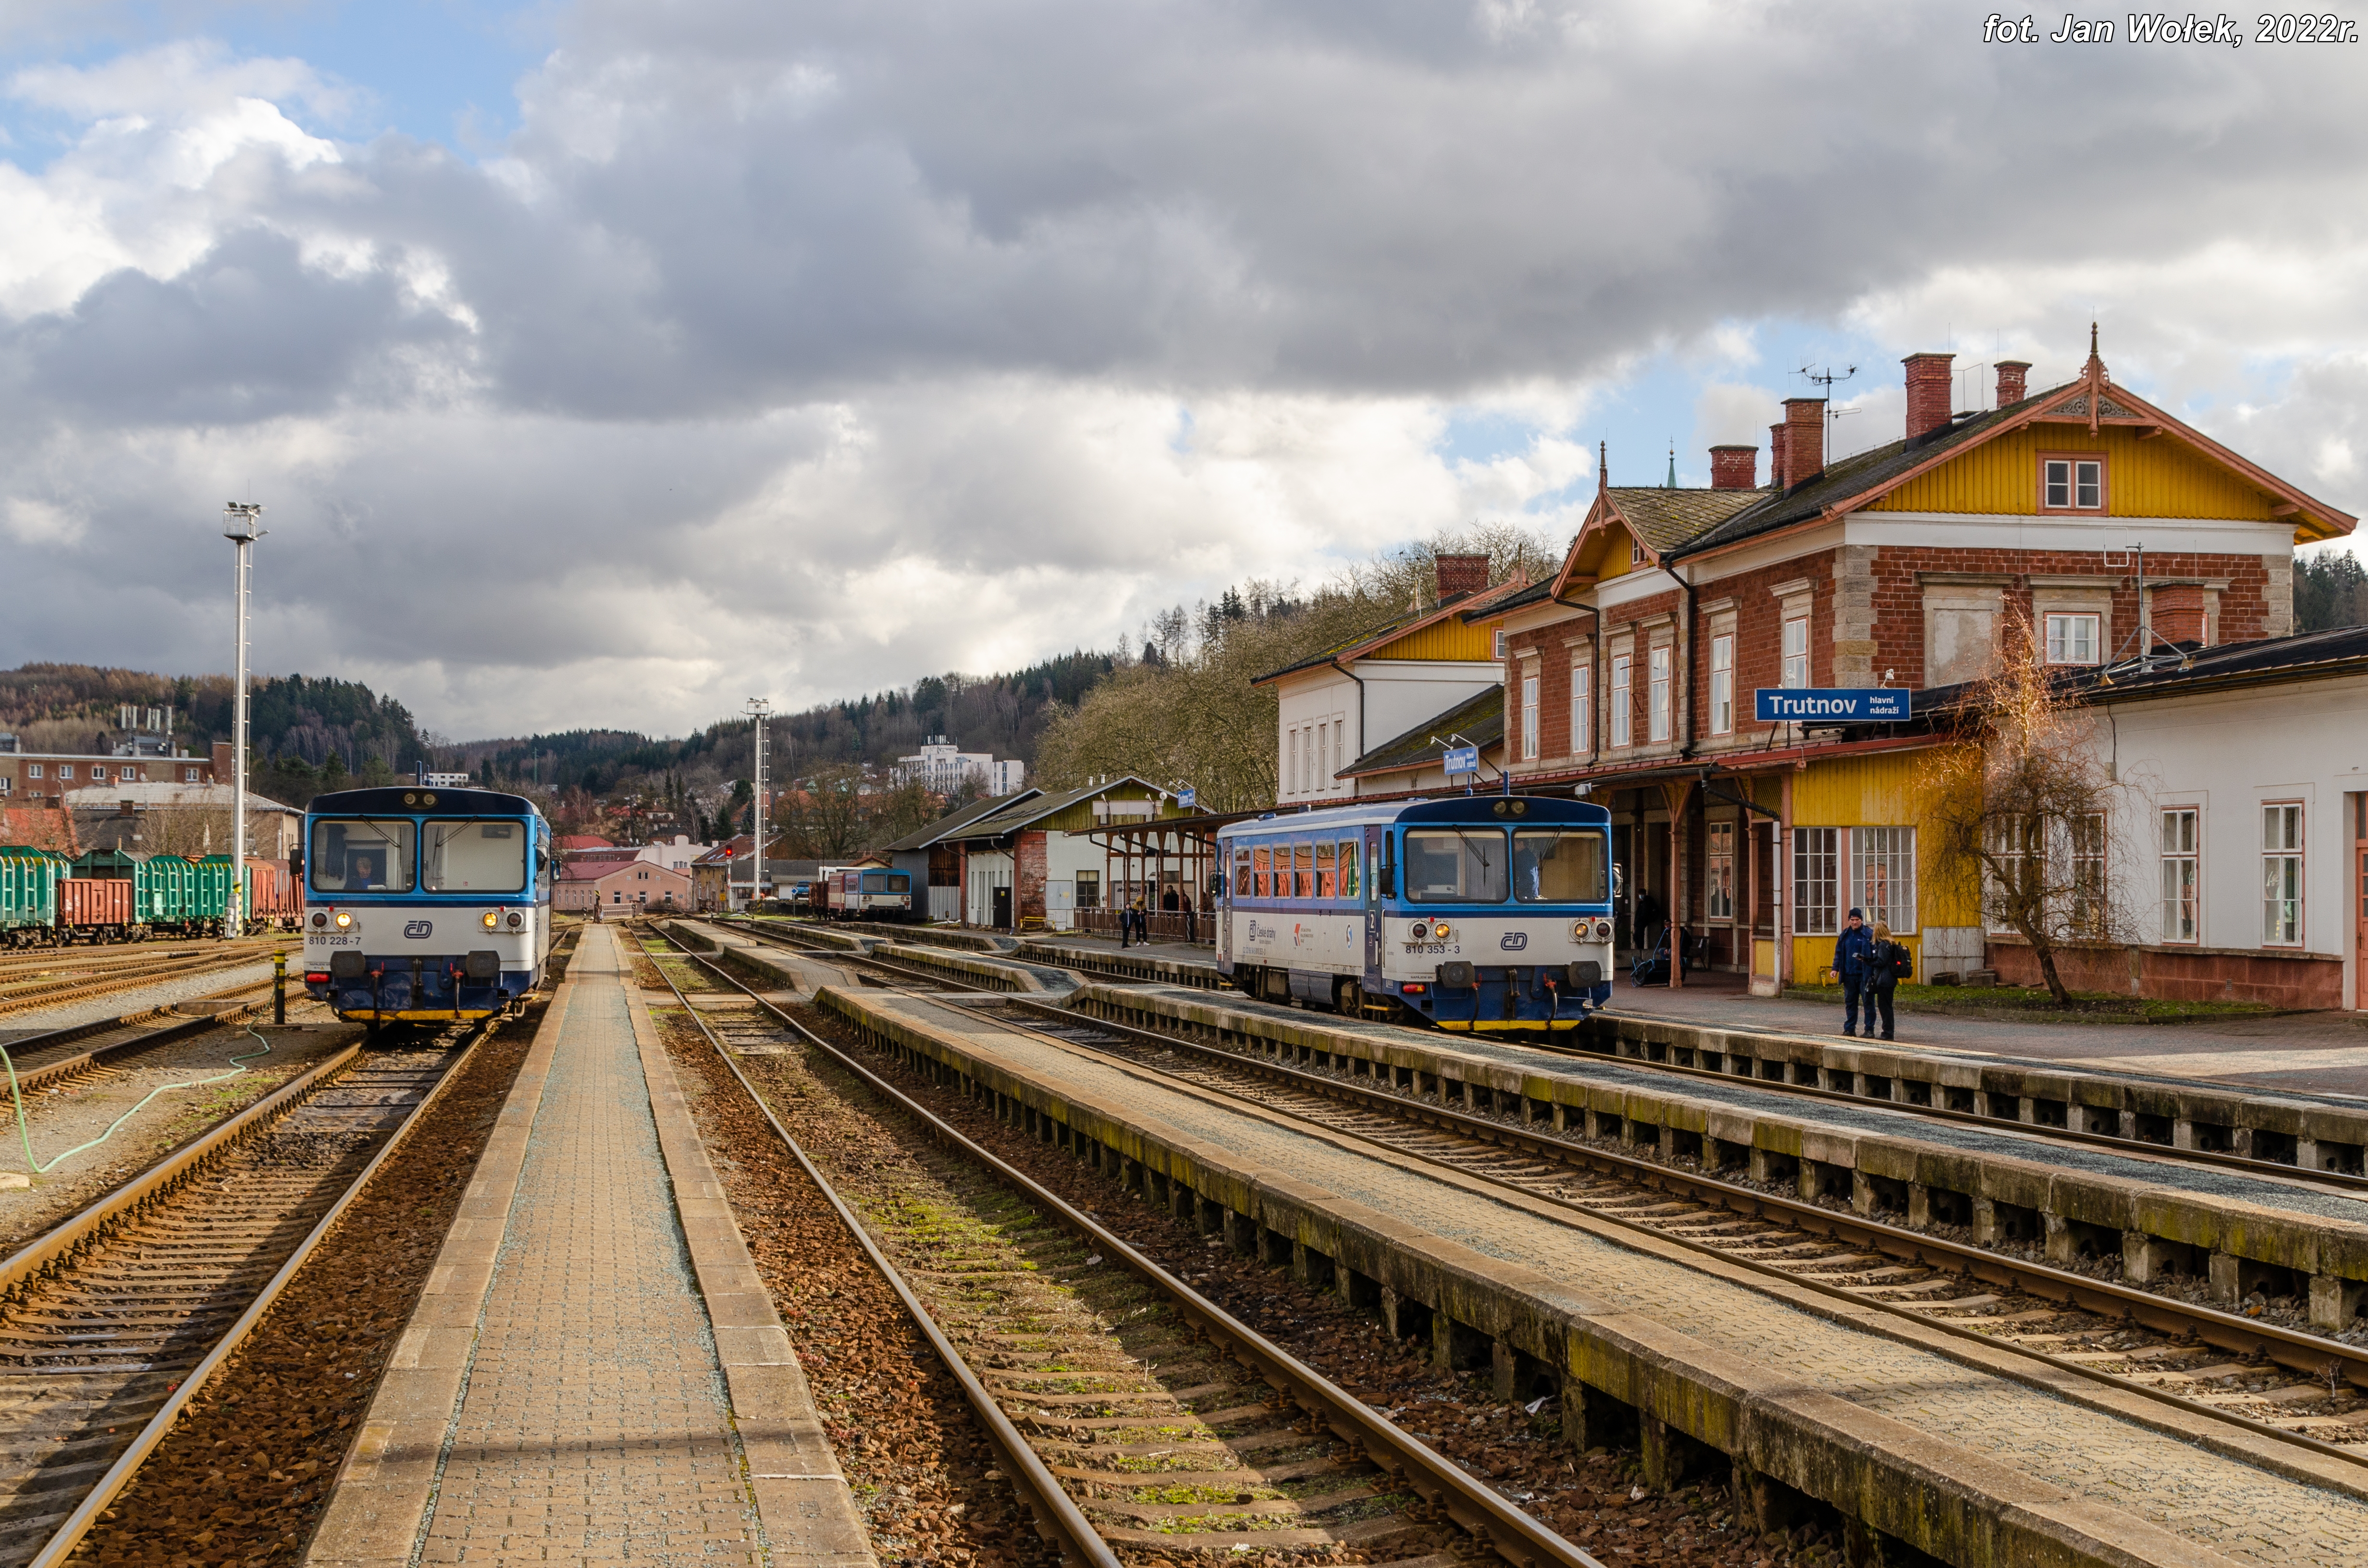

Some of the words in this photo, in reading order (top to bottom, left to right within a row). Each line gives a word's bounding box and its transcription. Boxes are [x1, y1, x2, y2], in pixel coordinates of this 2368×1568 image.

[1769, 696, 1857, 714] Trutnov
[1445, 755, 1466, 770] Trutnov
[1227, 909, 1230, 921] 2
[1370, 914, 1374, 929] 2
[1257, 924, 1266, 937] České
[1267, 927, 1276, 942] dráhy
[309, 937, 326, 945] 810
[1406, 945, 1424, 954] 810
